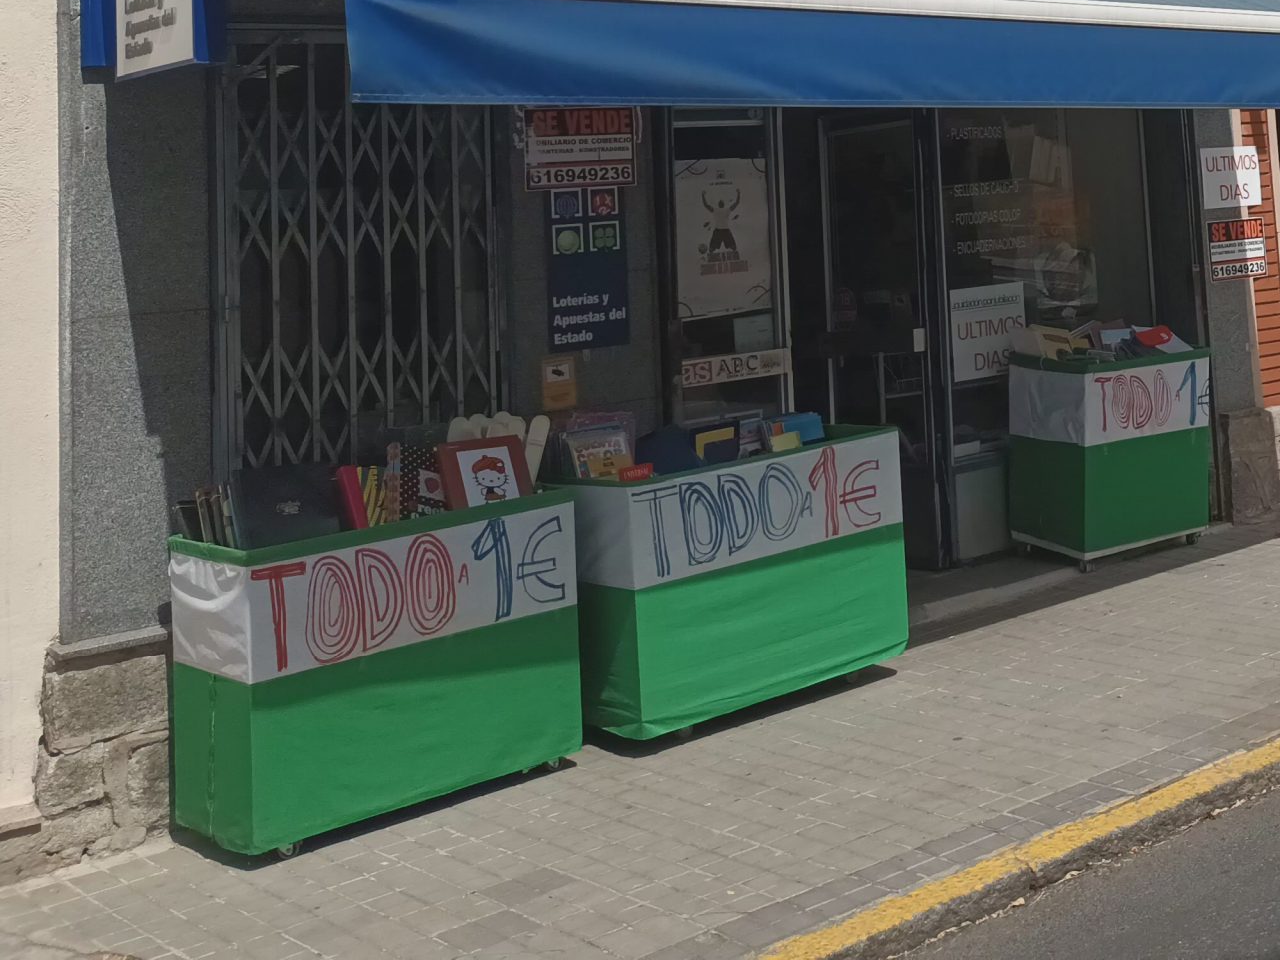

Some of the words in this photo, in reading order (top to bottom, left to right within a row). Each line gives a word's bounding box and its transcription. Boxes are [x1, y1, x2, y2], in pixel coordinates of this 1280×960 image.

[533, 111, 559, 136] SE
[565, 109, 632, 135] VENDE
[1205, 154, 1257, 172] ULTIMOS
[531, 166, 631, 184] 616949236
[1220, 183, 1249, 201] DIAS
[1211, 223, 1226, 242] SE
[1228, 220, 1263, 240] VENDE
[1212, 262, 1265, 277] 616949236
[602, 293, 609, 305] y
[554, 311, 605, 328] Apuestas
[609, 307, 626, 320] del
[957, 315, 1024, 340] ULTIMOS
[554, 330, 593, 345] Estado
[717, 355, 758, 376] ABC
[974, 349, 1009, 371] DIAS
[682, 361, 712, 385] as
[1094, 369, 1172, 432] TODO
[631, 462, 803, 577] TODO
[800, 491, 813, 517] A
[251, 533, 456, 672] TODO
[458, 563, 469, 585] A
